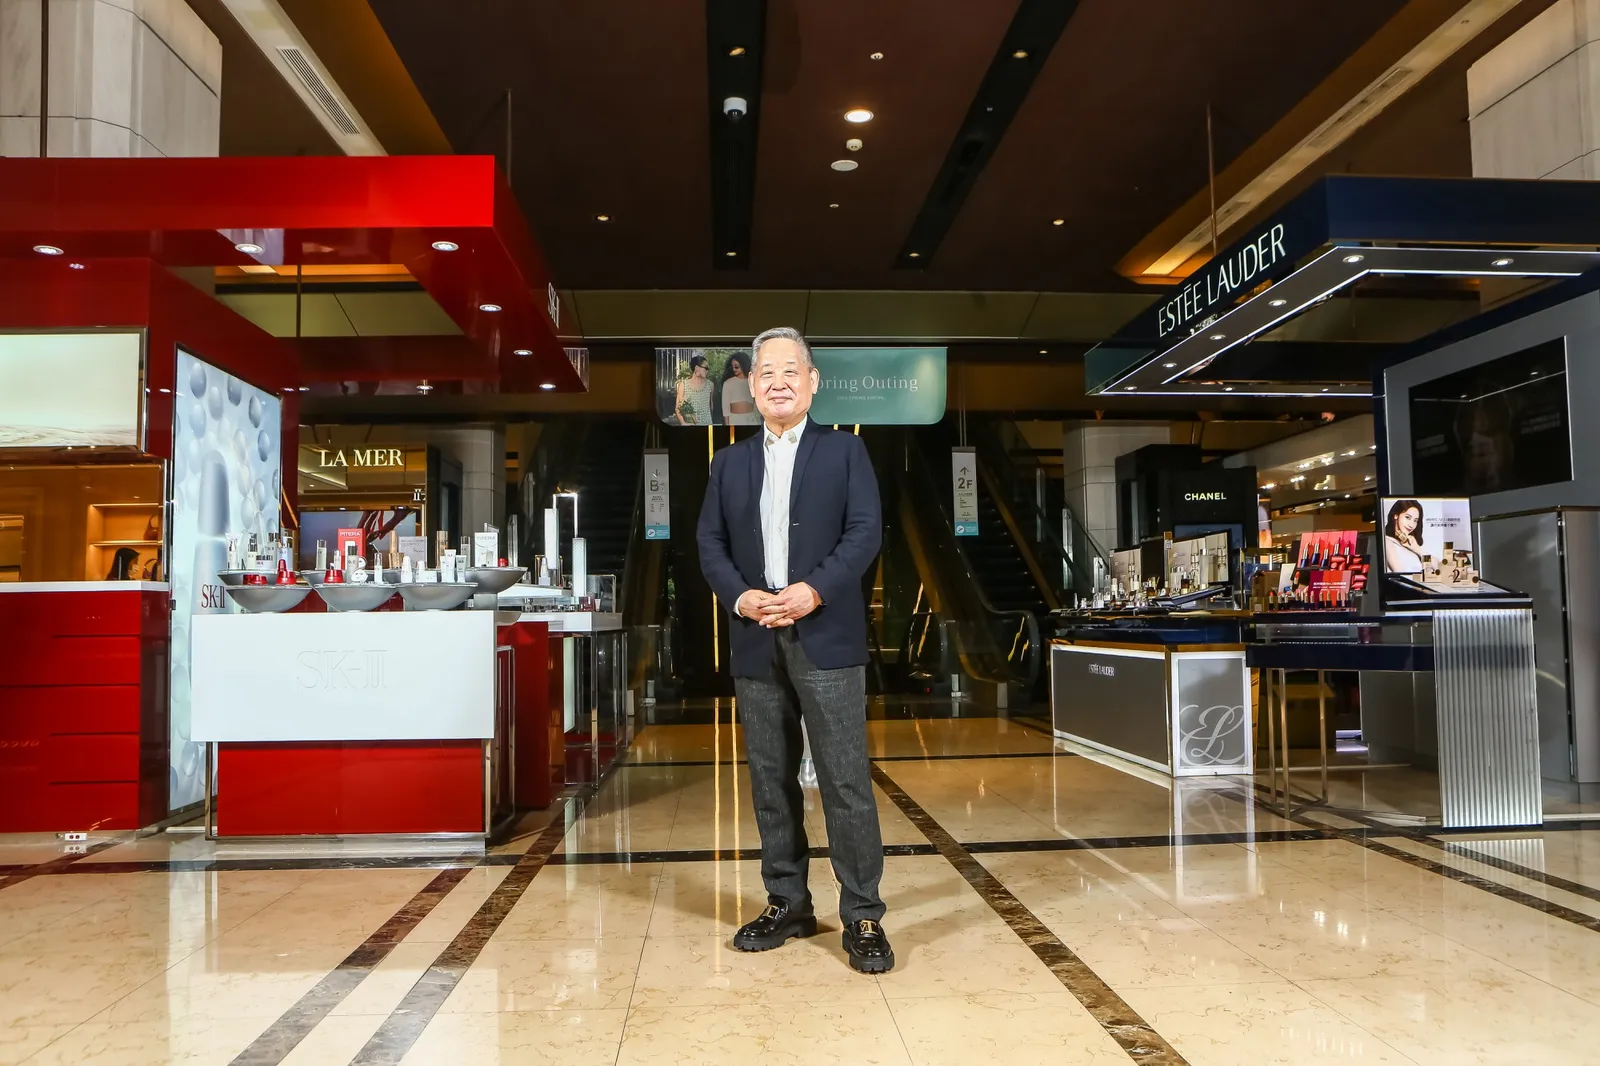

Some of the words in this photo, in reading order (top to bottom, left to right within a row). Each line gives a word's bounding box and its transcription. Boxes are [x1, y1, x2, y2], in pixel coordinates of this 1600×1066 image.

[1207, 223, 1286, 306] LAUDER
[818, 376, 858, 393] ring
[862, 375, 918, 392] Outing
[319, 449, 349, 467] LA
[353, 448, 404, 467] MER
[957, 477, 973, 489] 2F
[1184, 492, 1227, 501] CHANEL
[201, 584, 225, 608] SK-II
